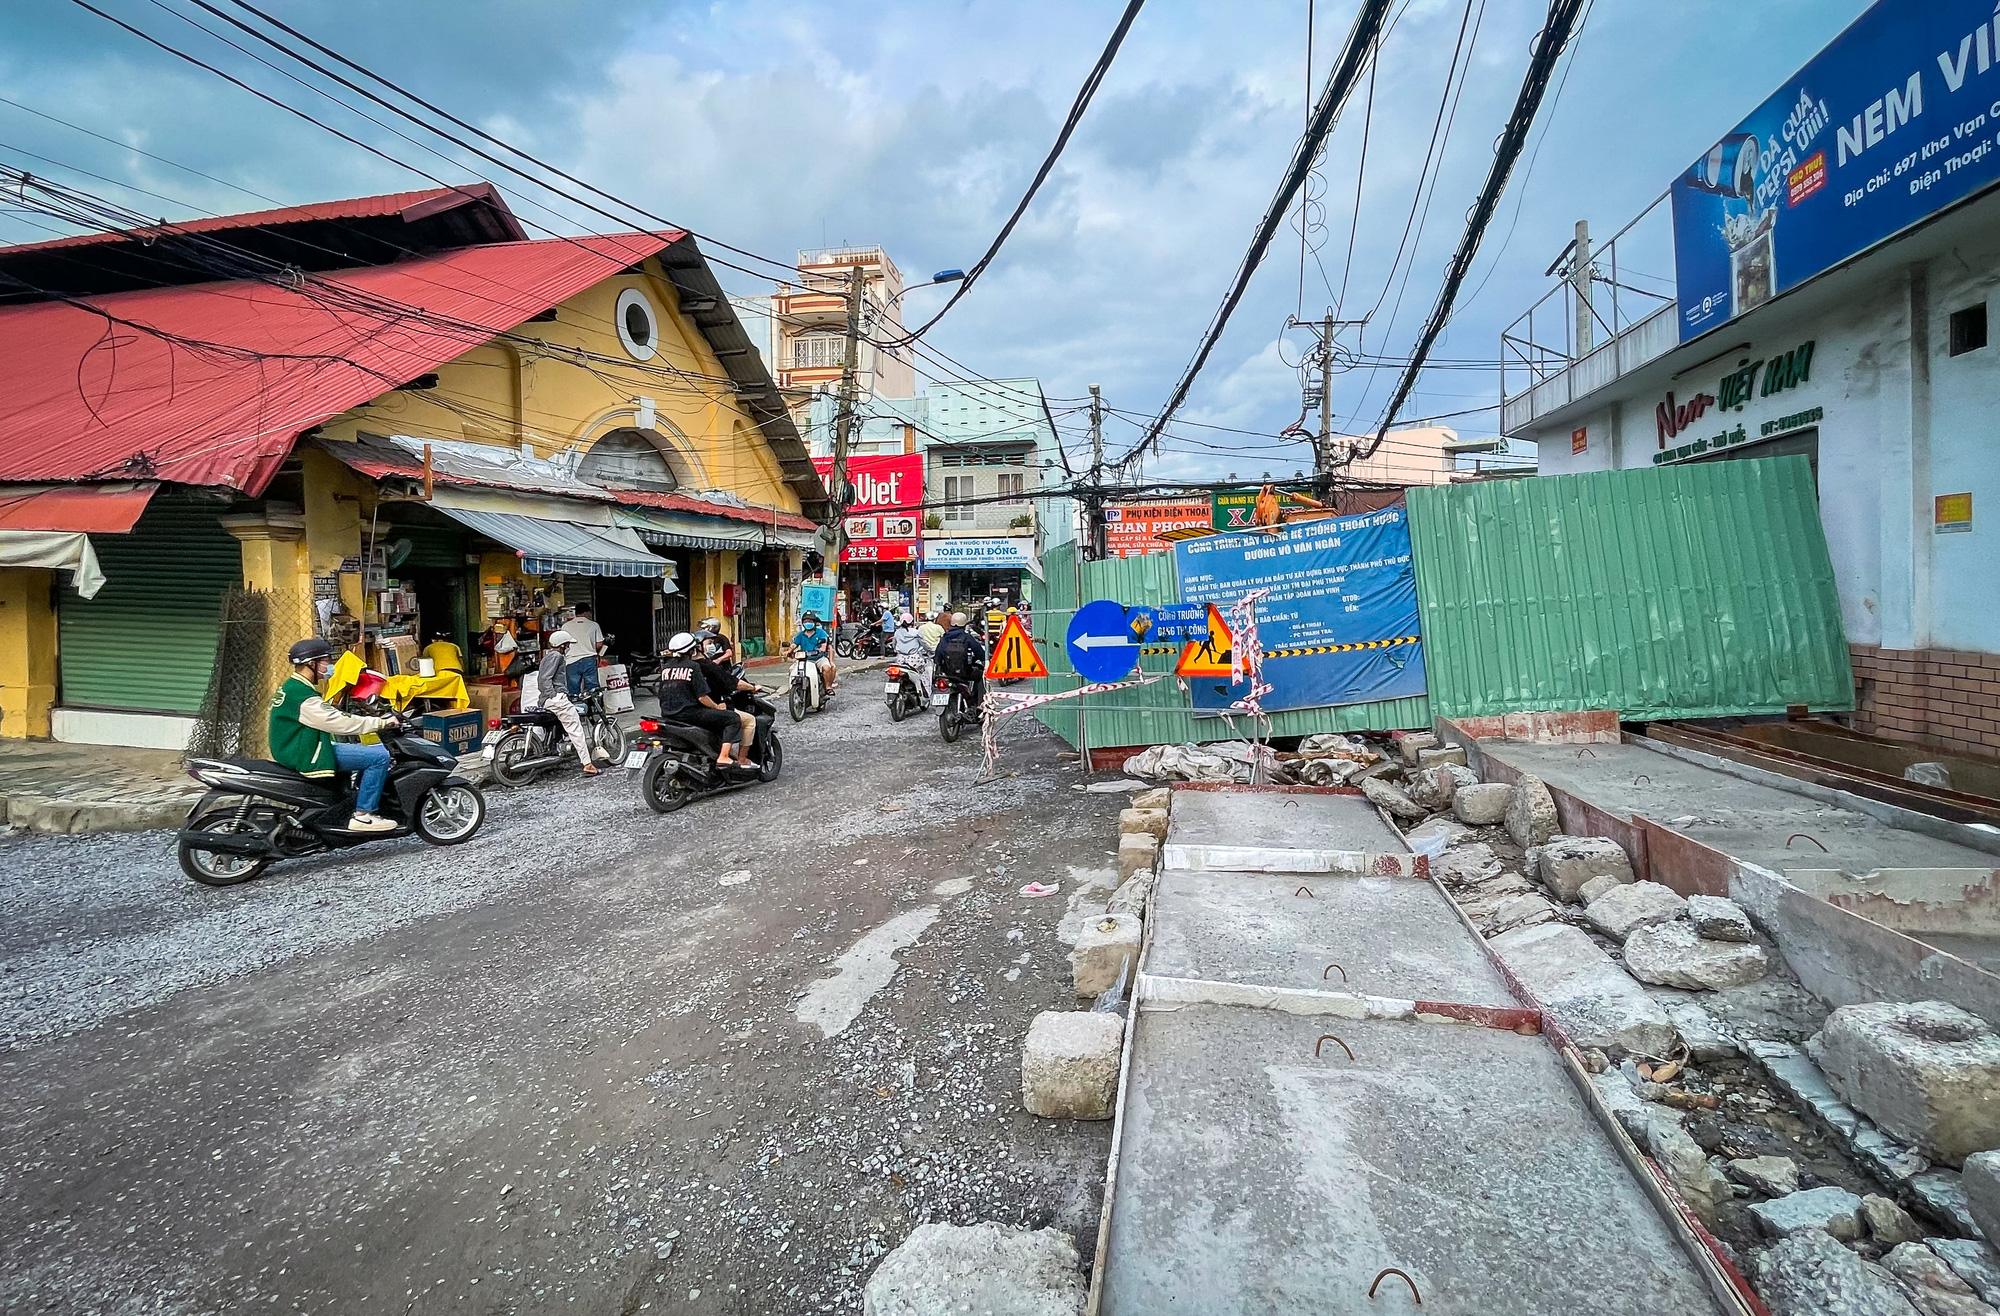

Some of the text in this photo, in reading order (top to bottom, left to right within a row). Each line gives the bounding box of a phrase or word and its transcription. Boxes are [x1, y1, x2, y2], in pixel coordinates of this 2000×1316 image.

[1782, 87, 1813, 143] QUÁ
[1837, 70, 1923, 168] NEM
[1844, 187, 1864, 208] Địa
[1867, 168, 1891, 193] Chỉ:
[1893, 151, 1917, 178] 697
[1921, 135, 1950, 161] Kha
[1953, 113, 1985, 140] Vạn
[1910, 167, 1941, 196] Điện
[1944, 139, 1992, 176] Thoại:
[1756, 146, 1798, 207] PEPSI
[1717, 357, 1765, 413] VIỆT
[1760, 340, 1816, 398] NAM
[1126, 507, 1209, 519] PHỤ KIỆN ĐIỆN THOẠI
[1151, 520, 1209, 533] PHONG
[1187, 541, 1212, 554] CÔNG
[1290, 528, 1303, 540] HỆ
[1315, 536, 1341, 551] NGÂN
[847, 546, 879, 557] 정관장
[936, 546, 963, 556] TOÀN
[965, 547, 985, 557] ĐẠI
[1384, 556, 1396, 566] THỦ
[1221, 589, 1237, 598] CÔNG
[1238, 588, 1246, 596] TY
[1312, 587, 1325, 597] ANH
[1325, 586, 1341, 595] VINH
[1177, 607, 1205, 621] TRƯỜNG
[1188, 623, 1207, 635] CÔNG
[670, 667, 694, 681] FAME
